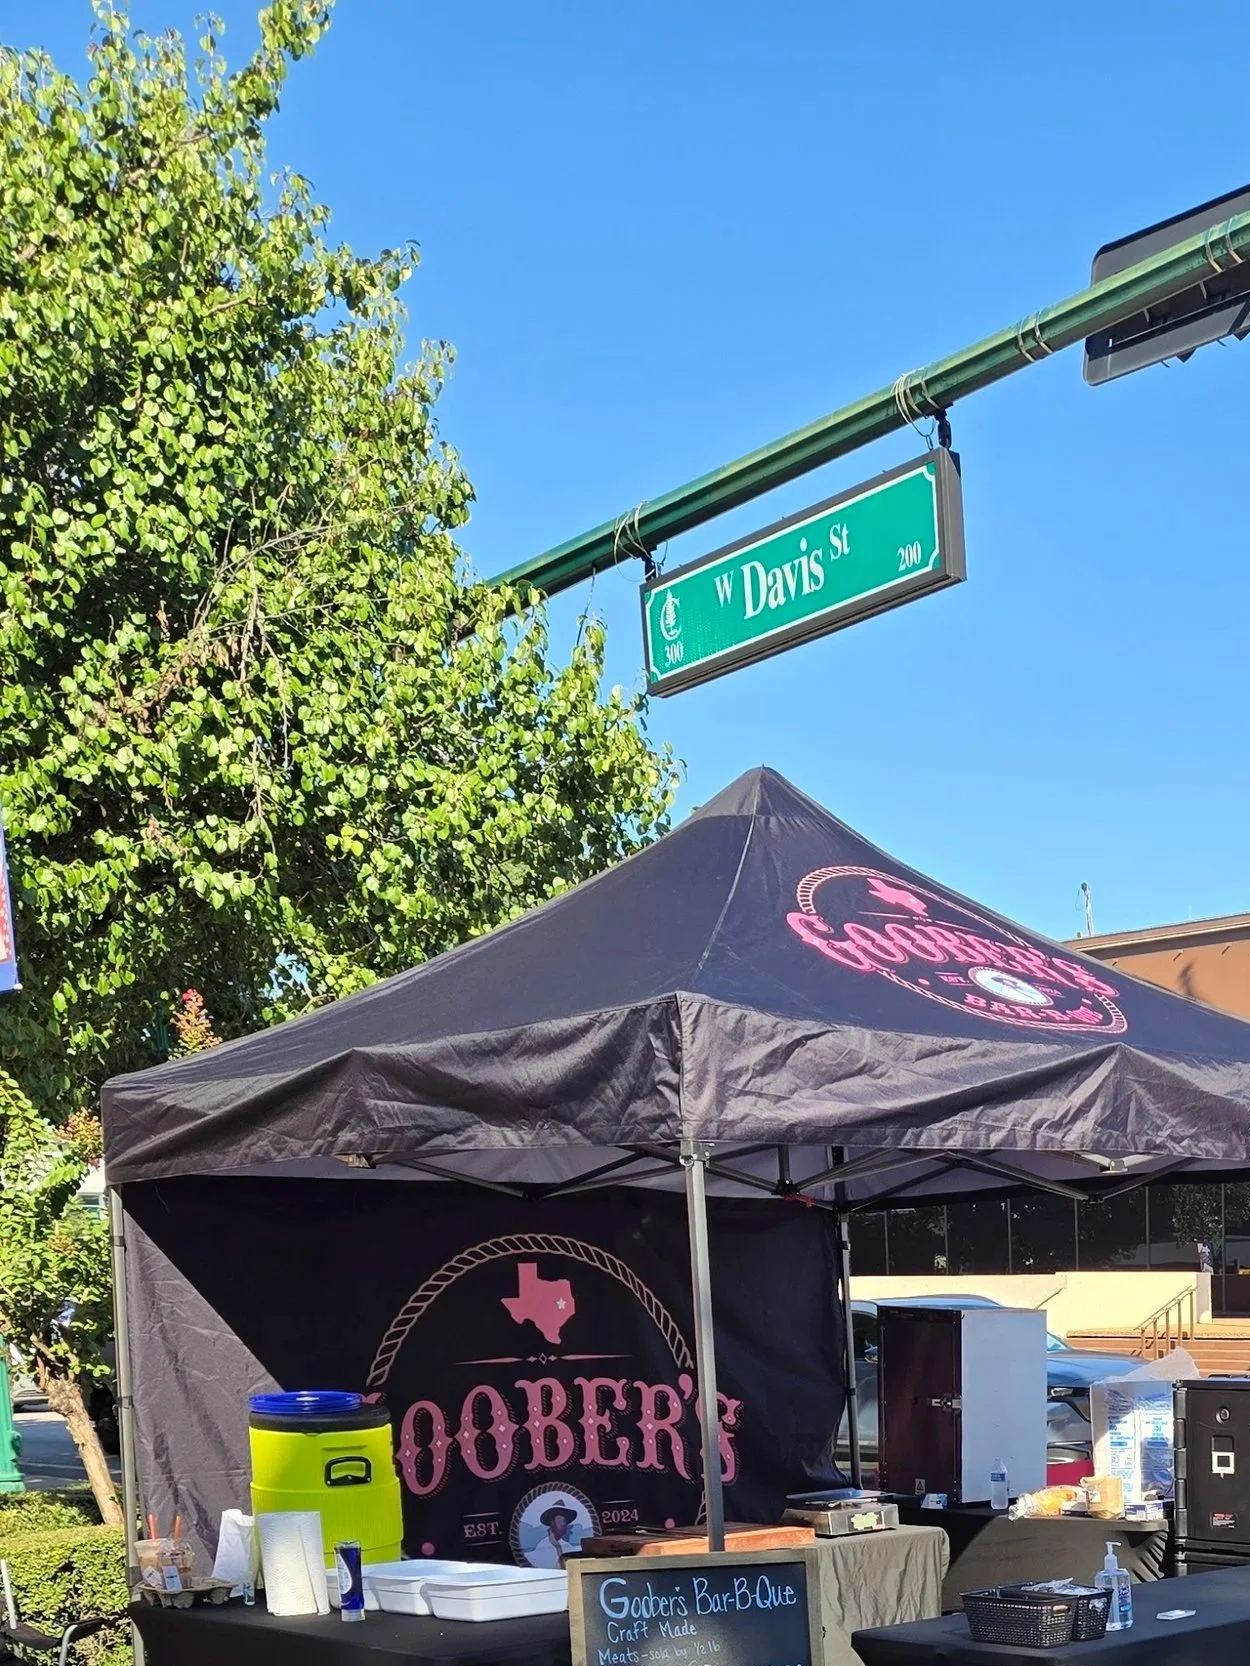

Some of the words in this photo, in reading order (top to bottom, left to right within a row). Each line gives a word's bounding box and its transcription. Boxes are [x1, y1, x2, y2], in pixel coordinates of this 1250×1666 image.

[714, 570, 734, 608] W
[742, 537, 825, 619] Davis
[829, 523, 850, 561] St
[897, 541, 922, 572] 200
[664, 641, 684, 668] 300
[361, 1373, 743, 1496] OOBER'S
[464, 1521, 501, 1538] EST.
[602, 1508, 639, 1523] 2024
[599, 1577, 688, 1619] Goober's
[692, 1575, 797, 1616] Bar-B-Que
[607, 1621, 649, 1643] Craft
[659, 1619, 698, 1639] Made
[673, 1645, 688, 1658] by
[708, 1640, 721, 1653] lb
